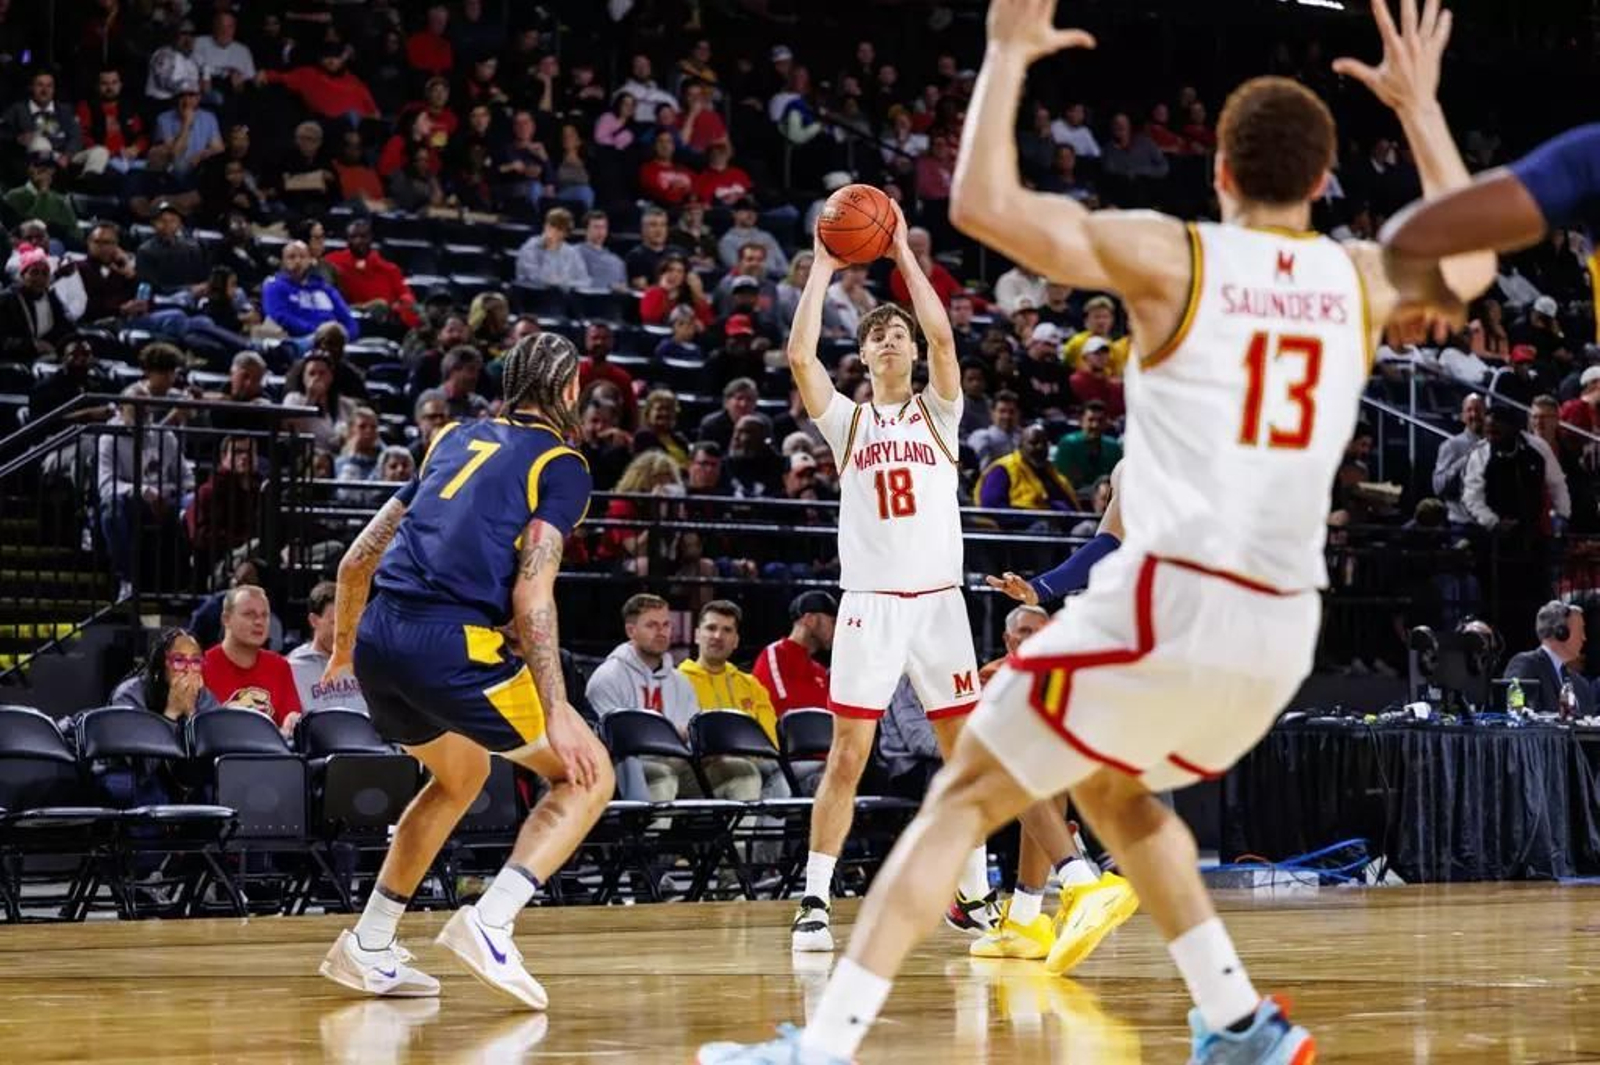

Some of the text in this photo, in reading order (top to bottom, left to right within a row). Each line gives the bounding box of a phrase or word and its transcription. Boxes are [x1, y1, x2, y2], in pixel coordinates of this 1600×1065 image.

[1221, 284, 1347, 324] SAUNDERS
[1237, 330, 1323, 449] 13
[439, 438, 501, 500] 7
[853, 440, 937, 470] MARYLAND
[874, 467, 916, 520] 18
[311, 677, 361, 699] GONZAG
[952, 670, 974, 694] M
